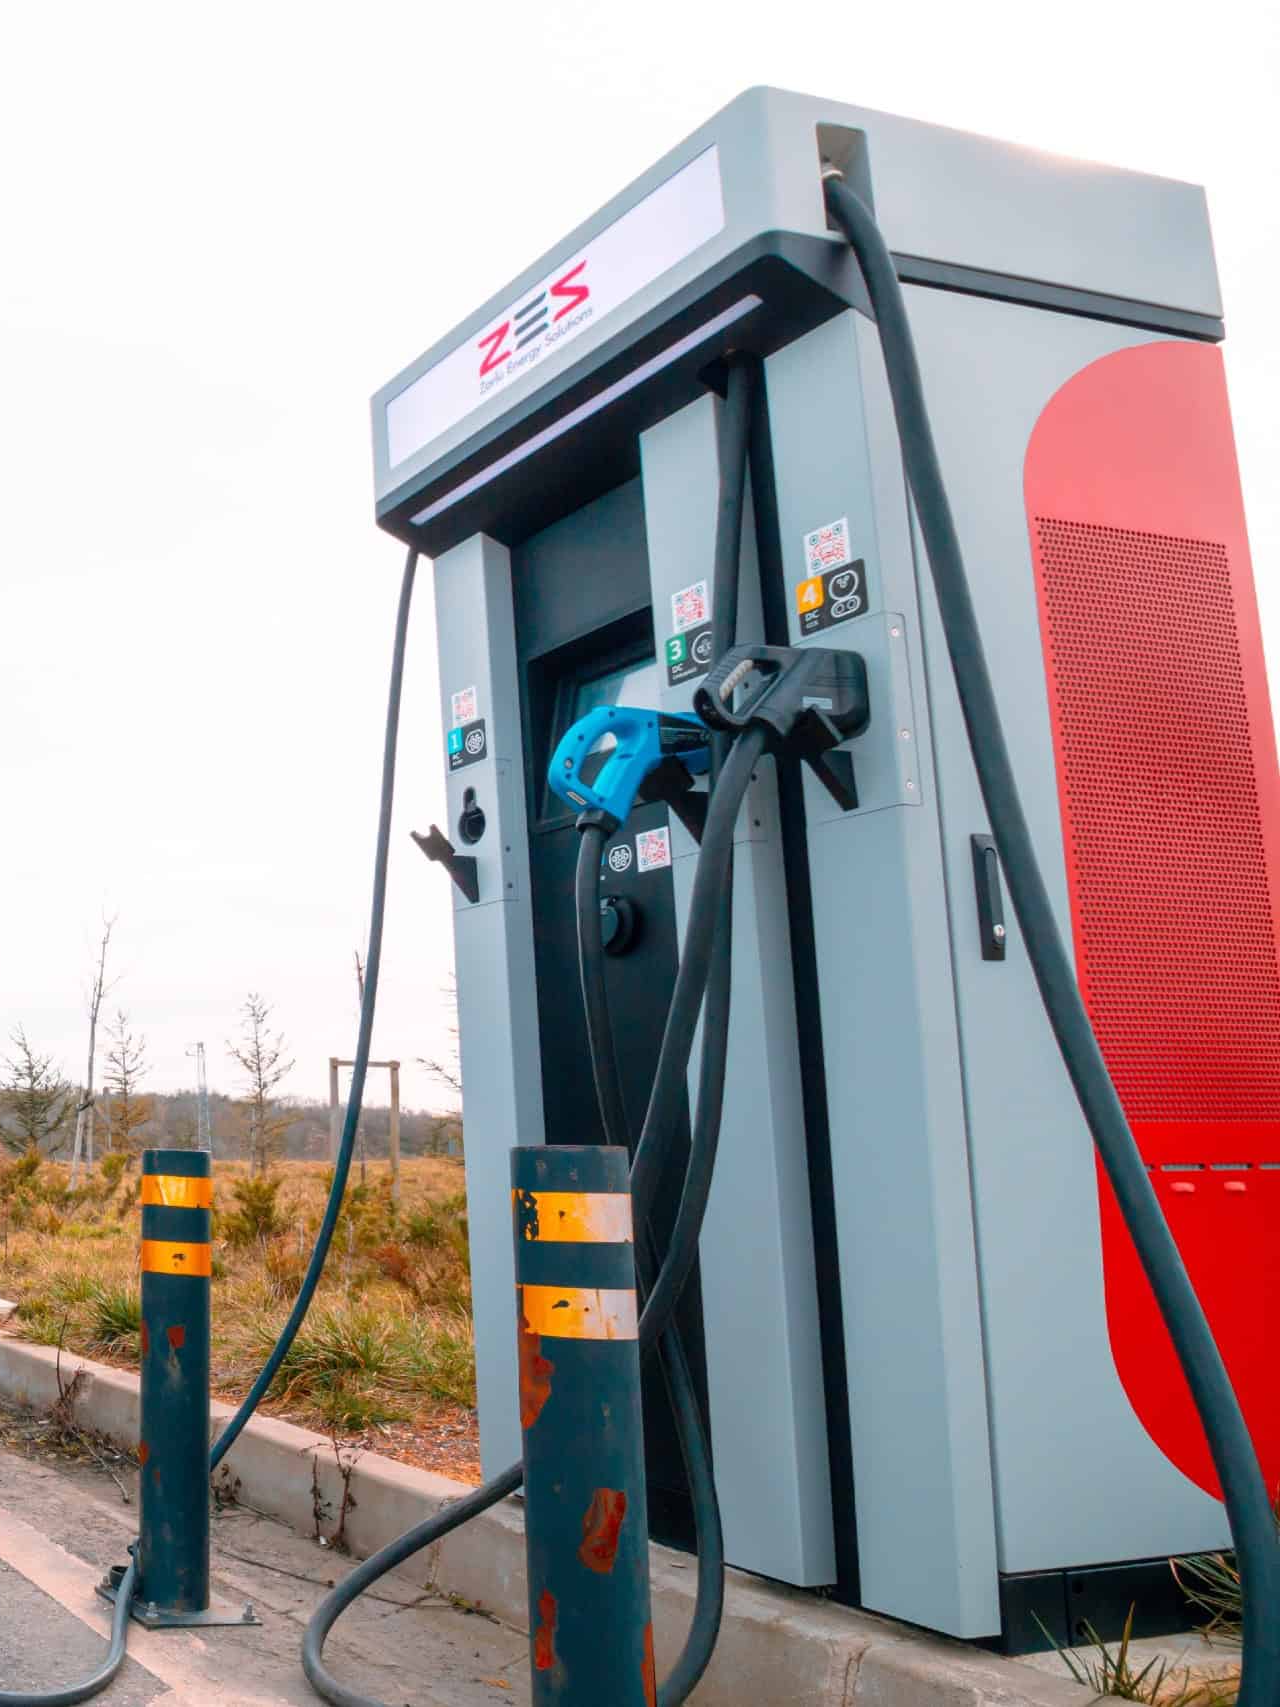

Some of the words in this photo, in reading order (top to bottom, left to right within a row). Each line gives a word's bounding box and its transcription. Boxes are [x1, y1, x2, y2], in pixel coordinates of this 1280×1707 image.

[478, 260, 590, 377] ZES
[801, 583, 818, 605] 4
[670, 639, 682, 660] 3
